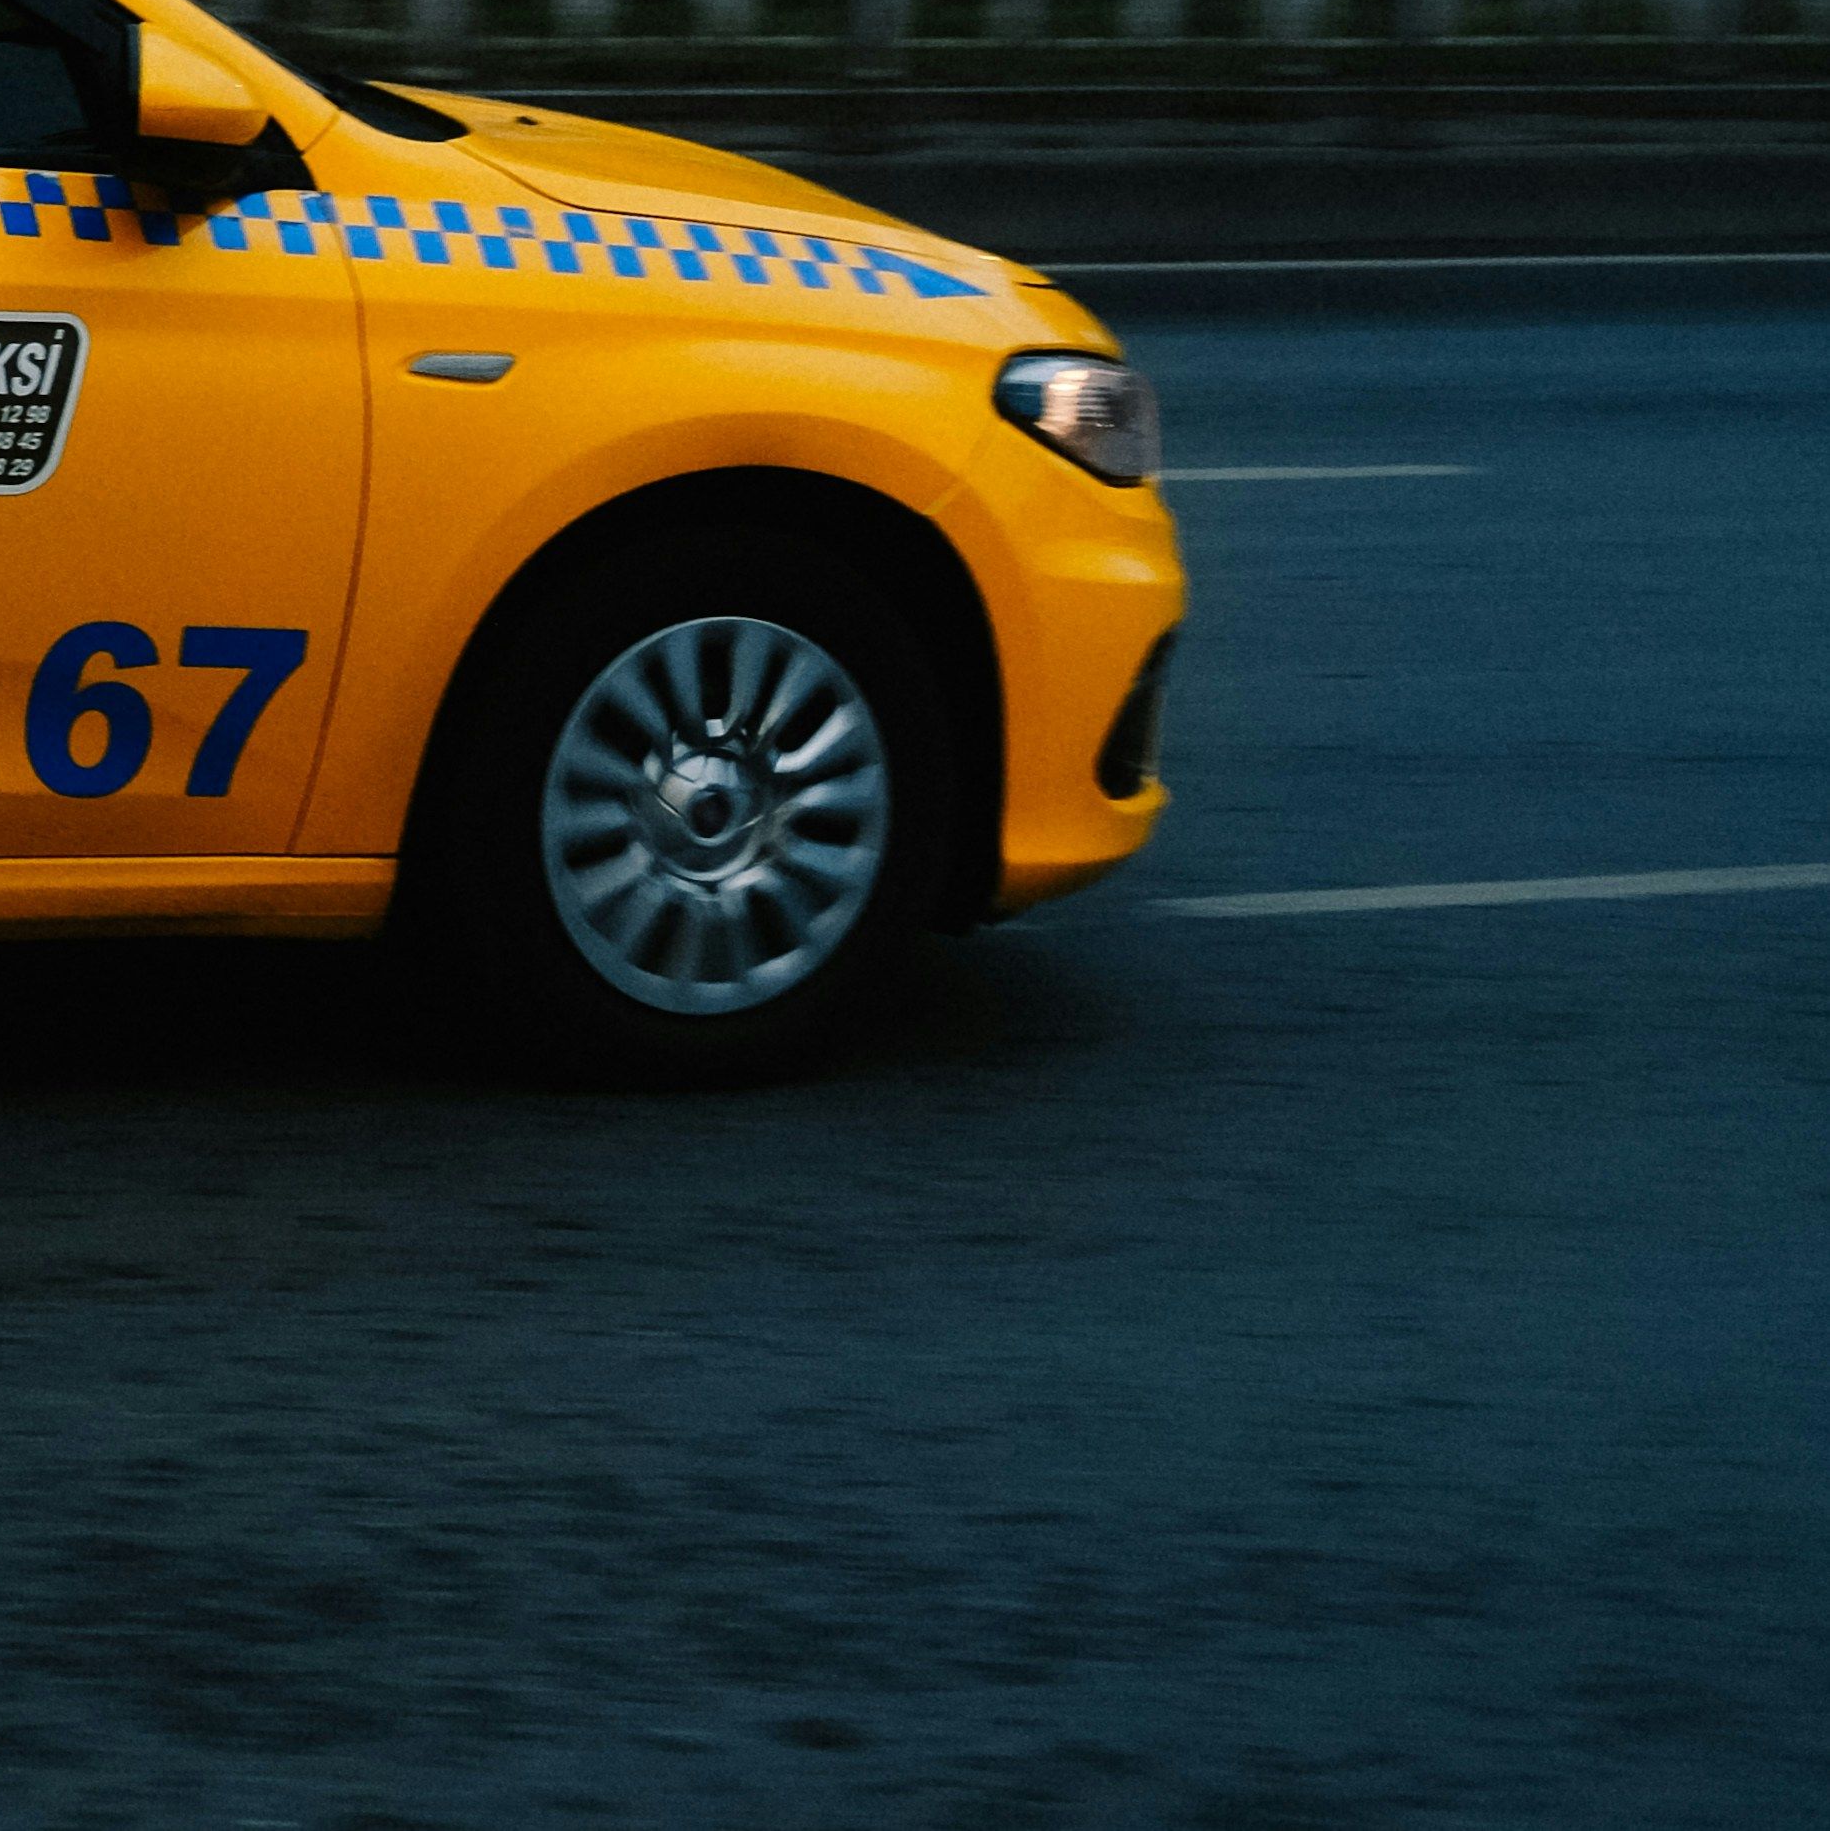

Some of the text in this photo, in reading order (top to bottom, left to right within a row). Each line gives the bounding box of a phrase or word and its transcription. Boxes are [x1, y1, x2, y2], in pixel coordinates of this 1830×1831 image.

[0, 404, 24, 423] 12
[17, 431, 44, 450] 45
[24, 620, 309, 799] 67
